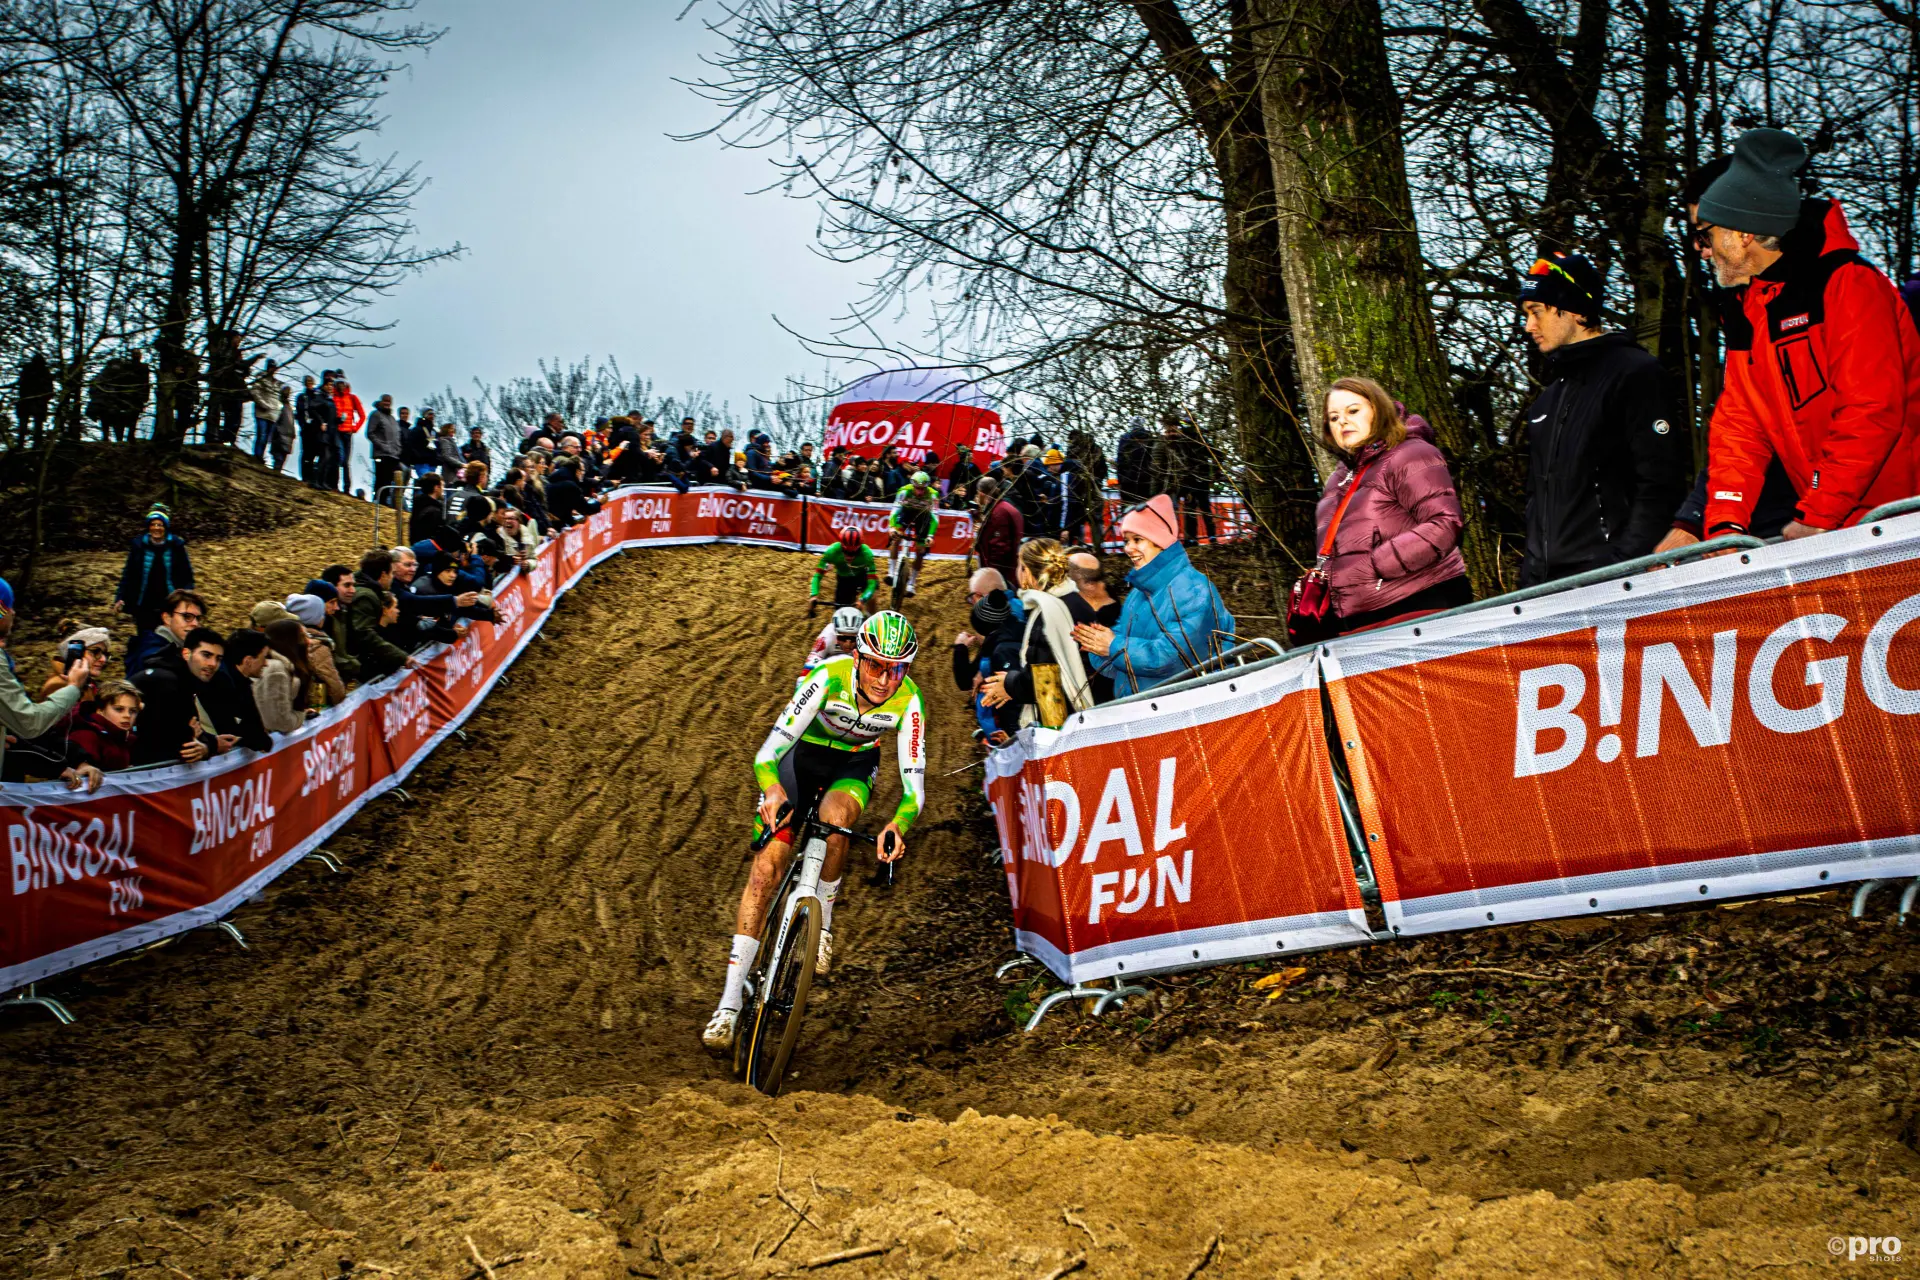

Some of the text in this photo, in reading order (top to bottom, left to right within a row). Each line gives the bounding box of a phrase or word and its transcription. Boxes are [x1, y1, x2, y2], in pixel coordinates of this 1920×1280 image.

[651, 520, 672, 533] FUN
[748, 521, 777, 536] FUN
[793, 682, 819, 715] crelan
[839, 715, 888, 733] crelan
[911, 711, 921, 759] corendon
[337, 767, 355, 801] FUN
[249, 822, 274, 862] FUN
[108, 875, 145, 916] FUN
[1088, 849, 1194, 925] FUN
